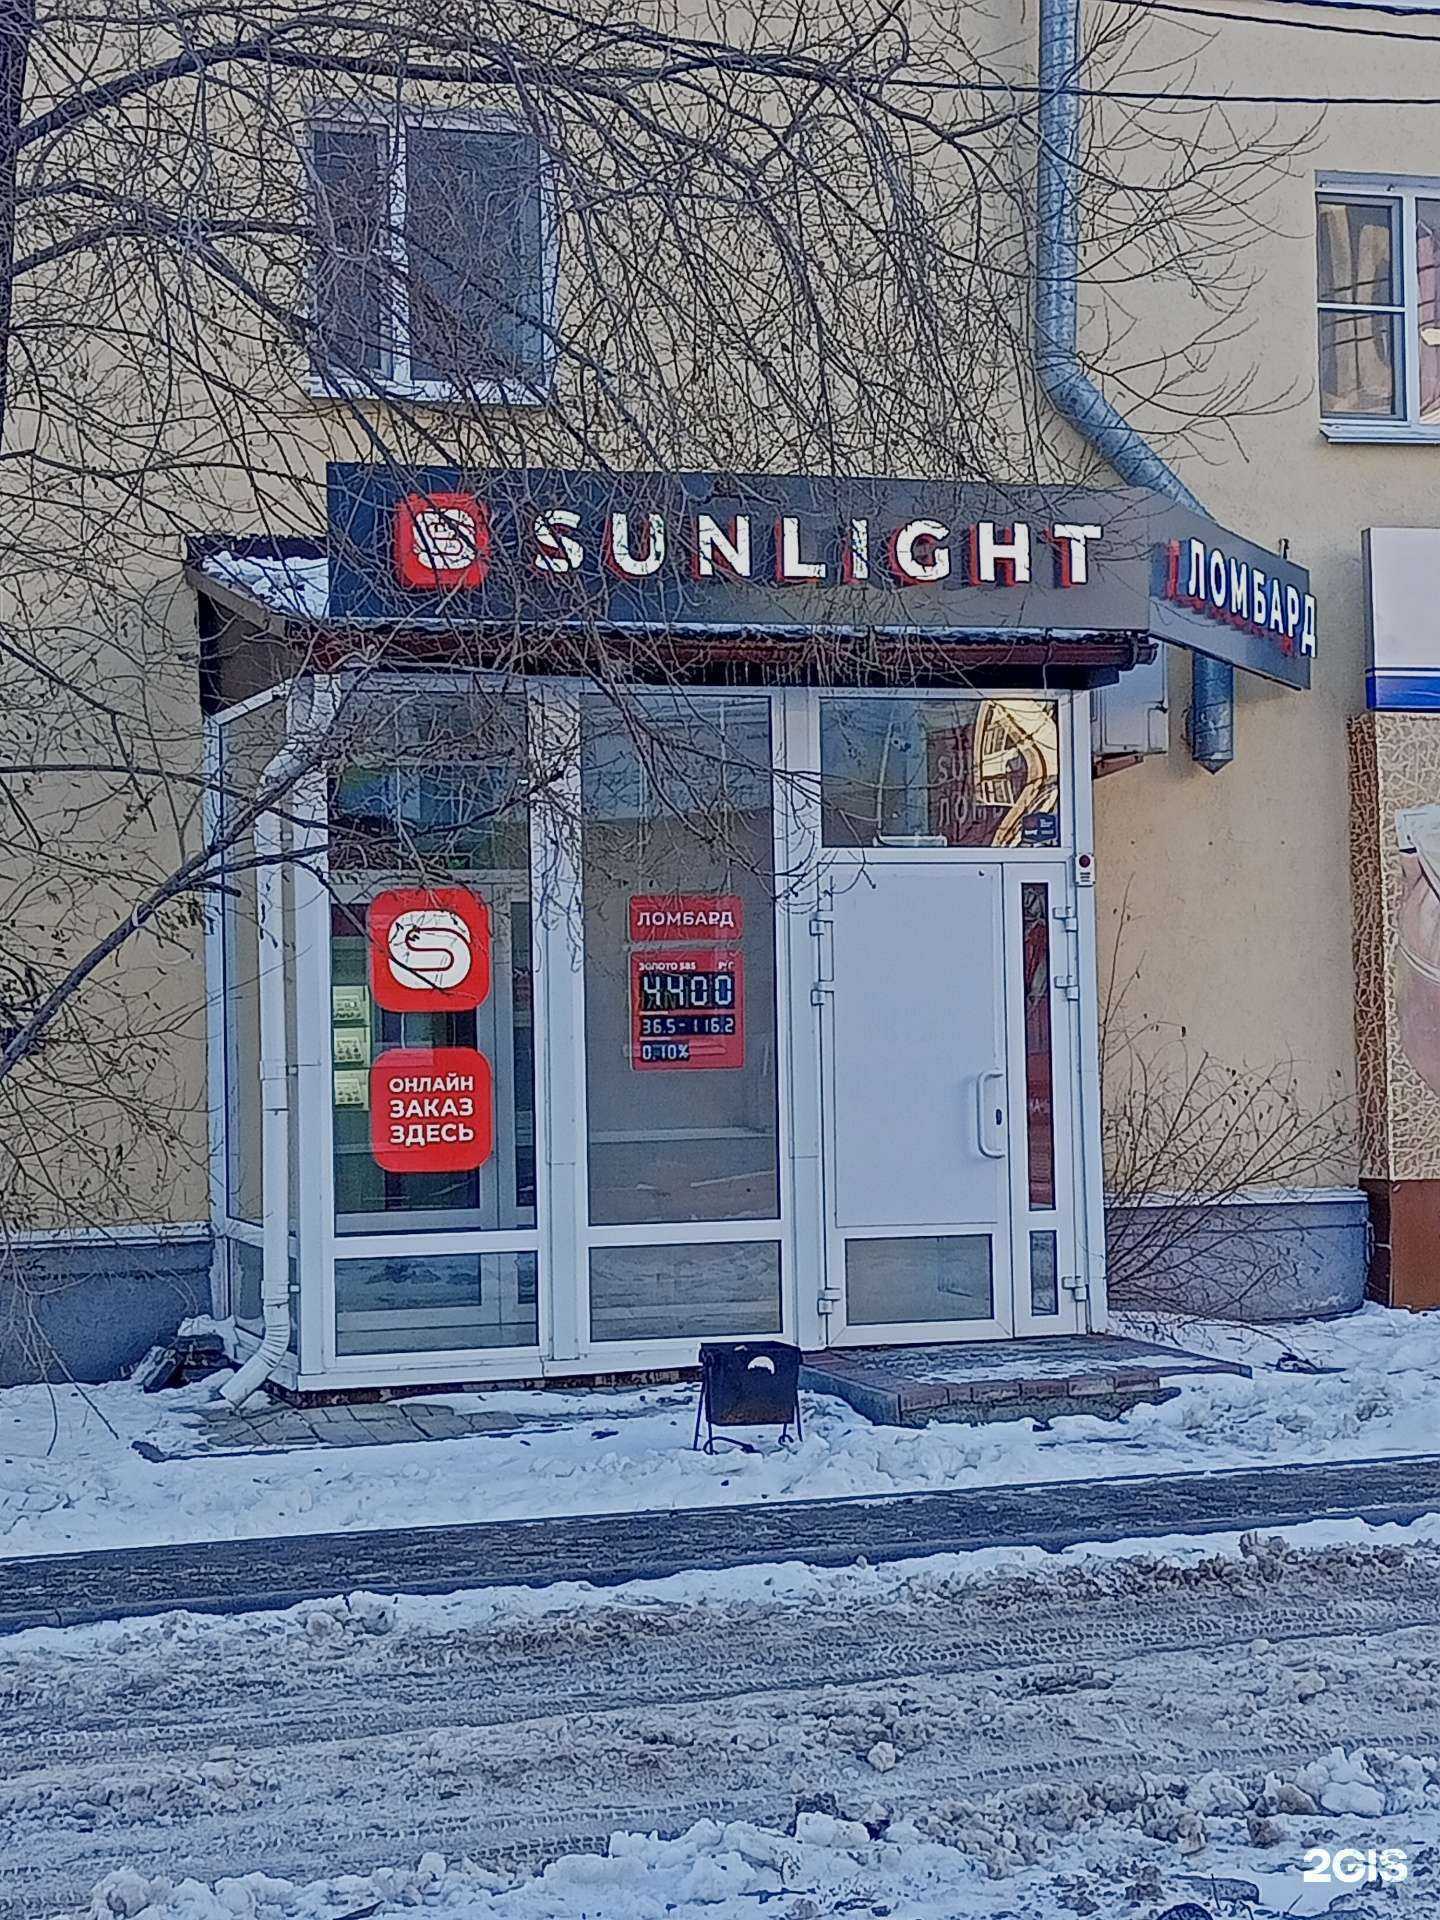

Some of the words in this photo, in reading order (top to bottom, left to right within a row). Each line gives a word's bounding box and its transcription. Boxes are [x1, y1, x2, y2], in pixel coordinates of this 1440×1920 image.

[533, 509, 1103, 585] SUNLIGHT
[1187, 538, 1318, 659] ЛОМБАРД
[637, 911, 735, 928] ЛОМБАРД
[638, 962, 678, 972] ЗОЛОТО
[679, 961, 697, 971] 585
[643, 974, 732, 1006] 4400
[388, 1072, 474, 1093] ОНЛАЙН
[389, 1097, 474, 1119] ЗАКАЗ
[389, 1123, 475, 1147] ЗДЕСЬ
